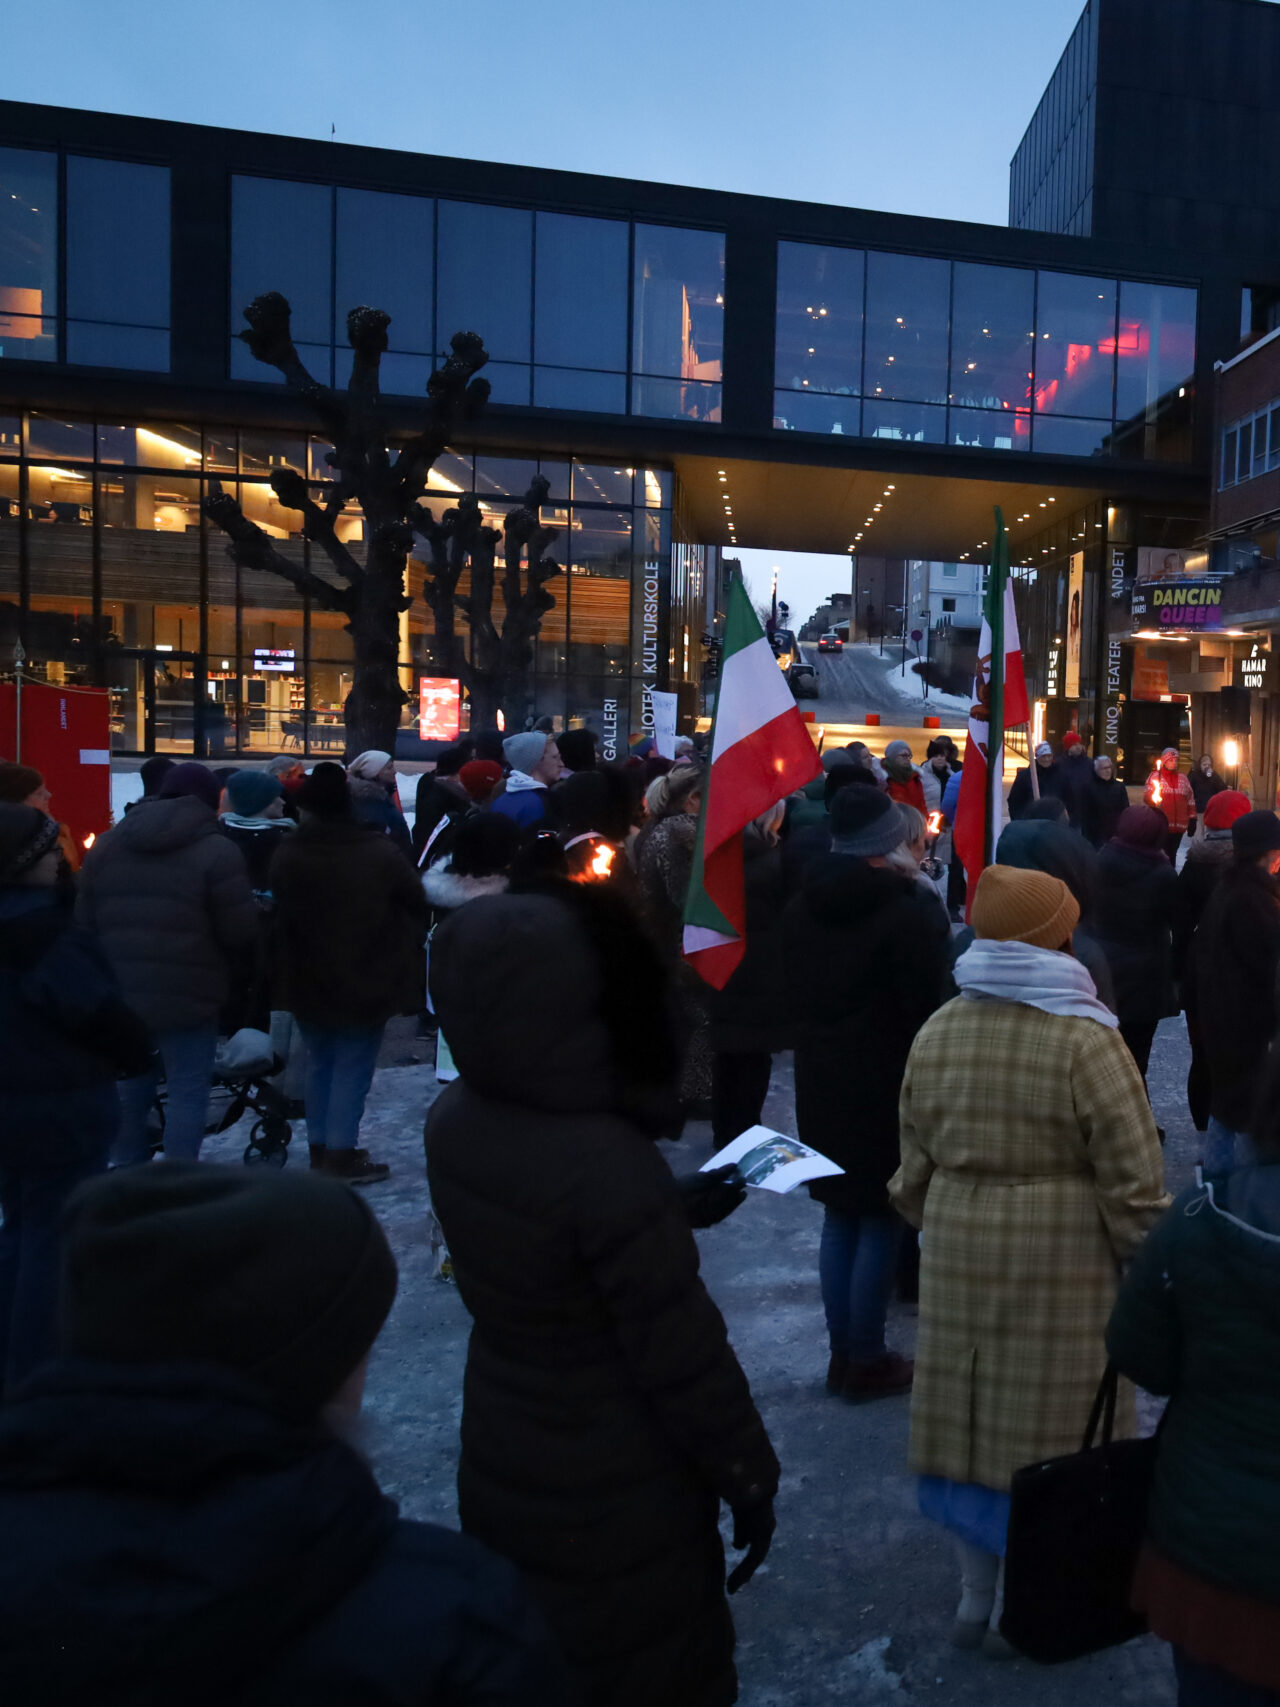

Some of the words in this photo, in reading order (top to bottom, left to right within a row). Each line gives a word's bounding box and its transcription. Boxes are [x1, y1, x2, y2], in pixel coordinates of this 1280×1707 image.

[1153, 588, 1221, 606] DANCIN
[643, 561, 659, 674] KULTURSKOLE
[1160, 606, 1221, 623] QUEEN
[1107, 639, 1121, 695] TEATER
[1241, 658, 1267, 673] HAMAR
[1244, 673, 1263, 688] KINO
[603, 698, 617, 761] GALLERI
[1105, 705, 1119, 745] KINO
